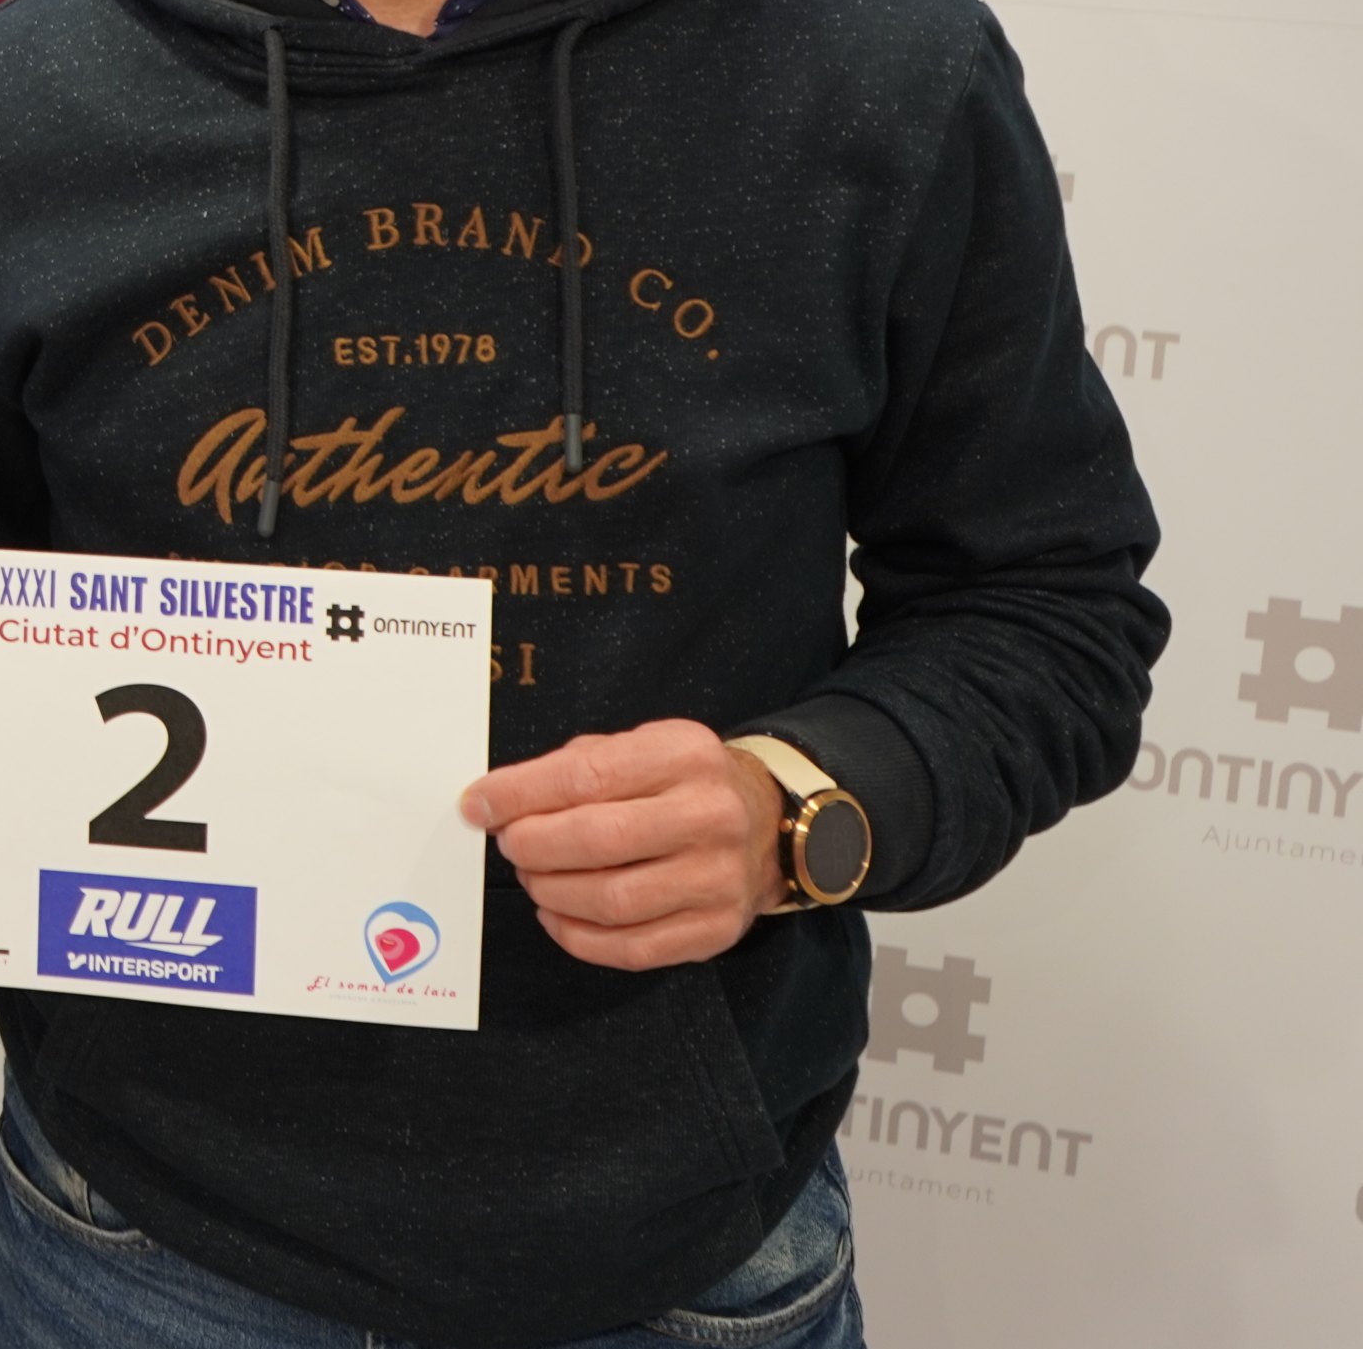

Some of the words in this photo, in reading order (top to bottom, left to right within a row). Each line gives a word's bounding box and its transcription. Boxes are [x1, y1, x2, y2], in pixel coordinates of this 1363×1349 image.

[132, 226, 332, 367] DENIM
[629, 268, 720, 361] CO.
[334, 333, 497, 366] EST.1978
[176, 406, 669, 525] Authentic
[0, 566, 56, 608] XXXI
[70, 572, 148, 613] SANT
[160, 577, 314, 624] SILVESTRE
[110, 625, 312, 663] d'Ontinyent
[374, 617, 477, 638] ONTINYENT
[89, 683, 207, 853] 2
[1201, 825, 1363, 866] Ajuntame
[69, 887, 223, 946] RULL
[88, 954, 220, 984] INTERSPORT
[397, 983, 414, 994] de
